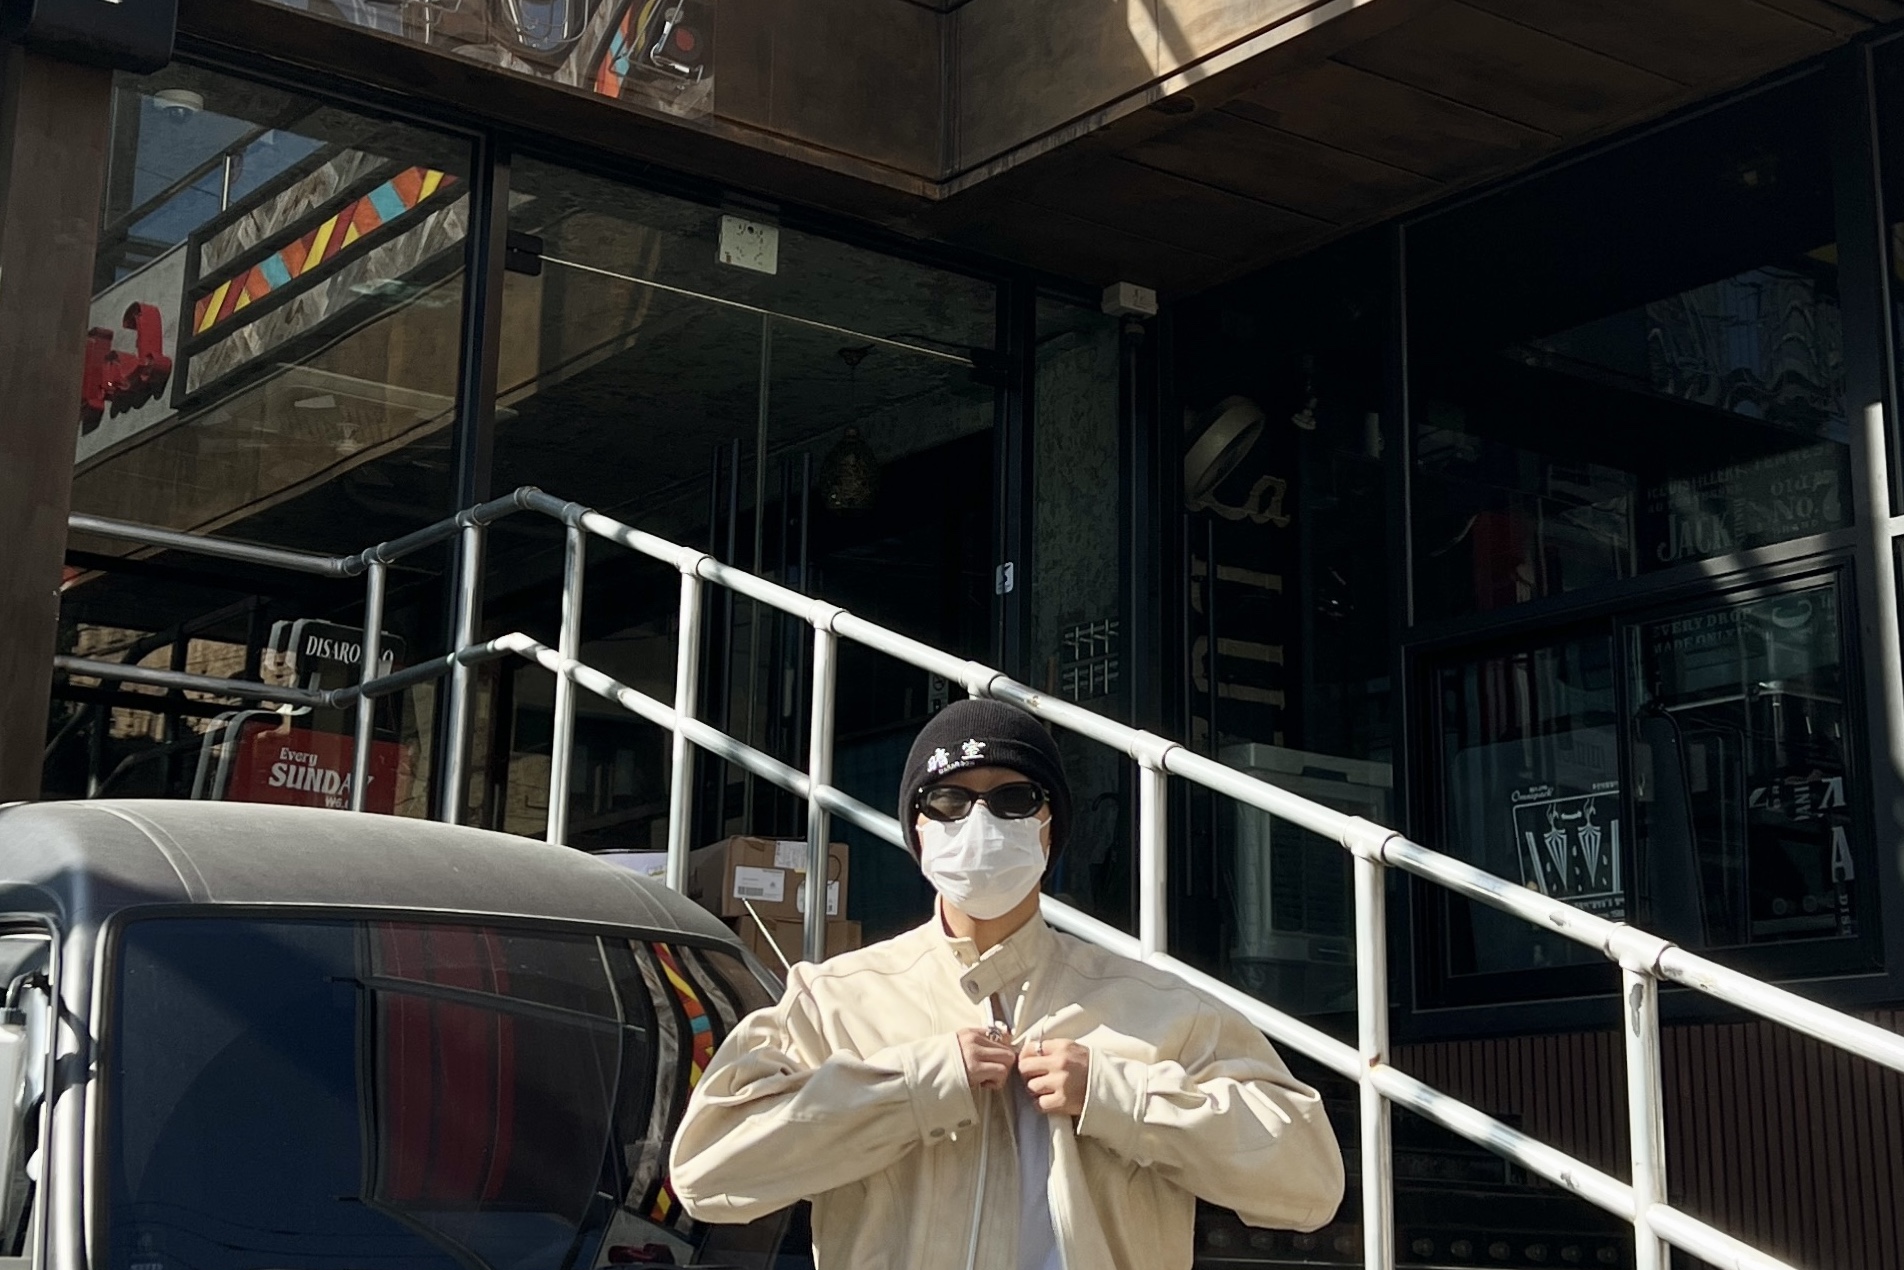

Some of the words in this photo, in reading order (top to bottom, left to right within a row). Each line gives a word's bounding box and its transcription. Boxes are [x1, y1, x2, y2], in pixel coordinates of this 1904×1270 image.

[1706, 607, 1752, 627] DROP
[305, 635, 395, 664] DISAROO
[279, 747, 319, 765] Every
[268, 762, 374, 795] SUNDA
